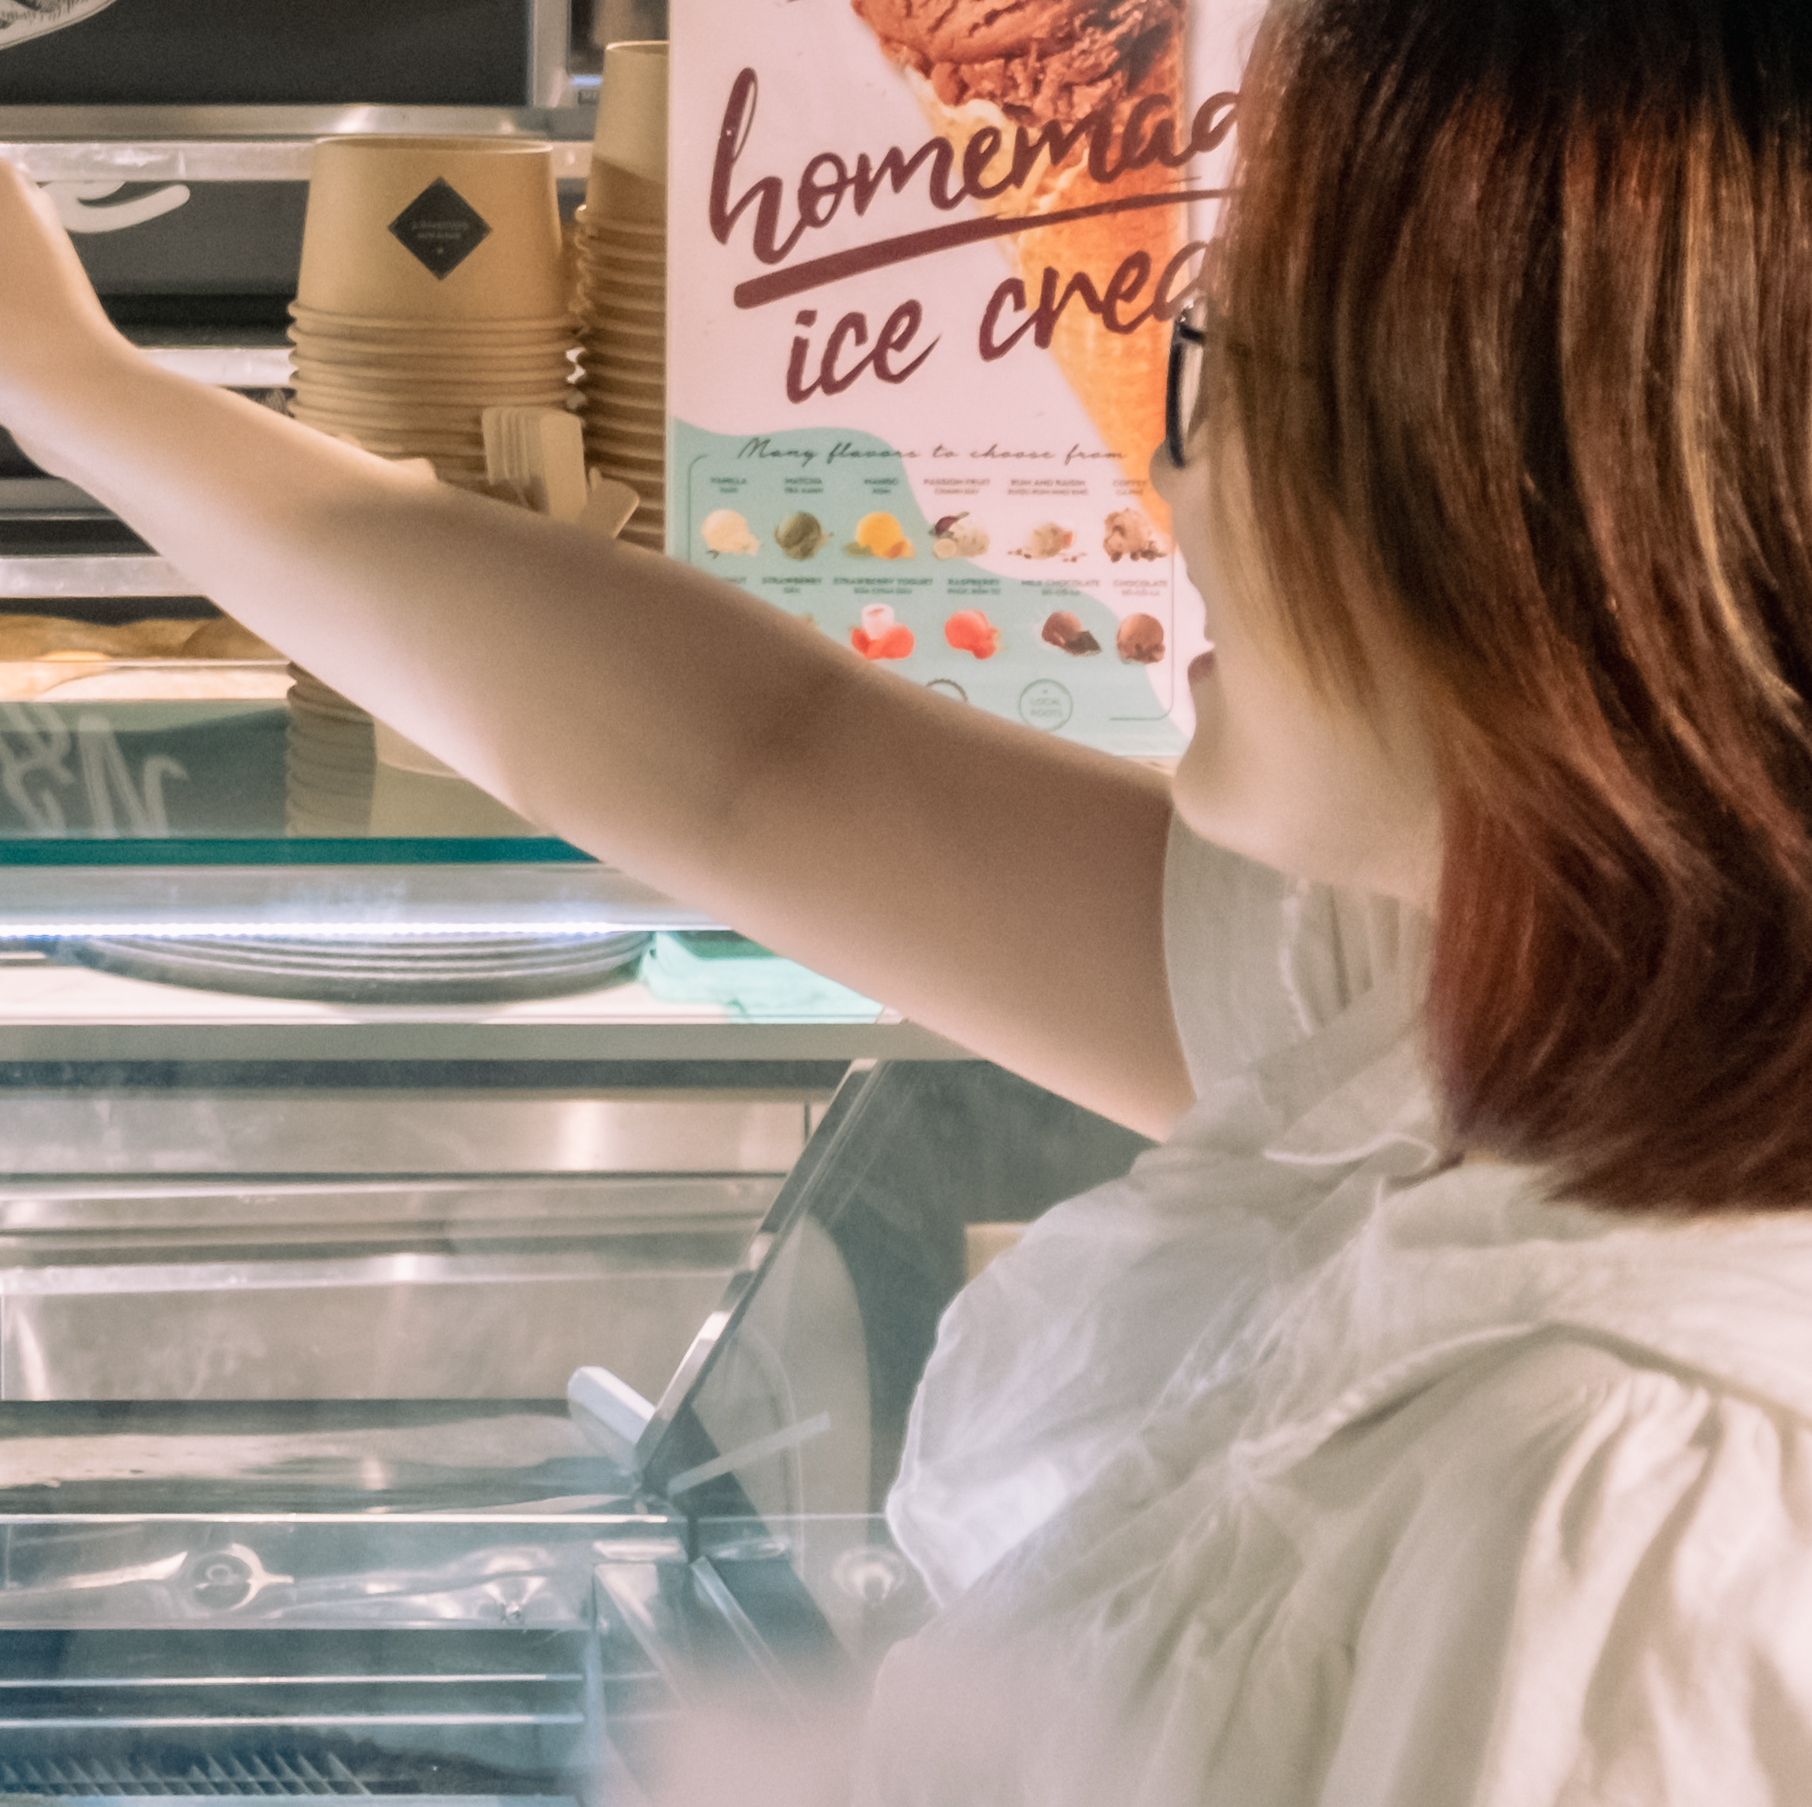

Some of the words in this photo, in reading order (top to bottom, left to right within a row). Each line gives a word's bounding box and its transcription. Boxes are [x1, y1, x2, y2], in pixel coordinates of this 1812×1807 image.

[707, 67, 1241, 264] homema
[784, 299, 942, 405] ice
[977, 240, 1215, 361] crea
[737, 437, 818, 468] Many
[826, 442, 921, 465] flavors
[931, 444, 959, 459] to
[970, 443, 1057, 459] choose
[1063, 443, 1127, 467] from
